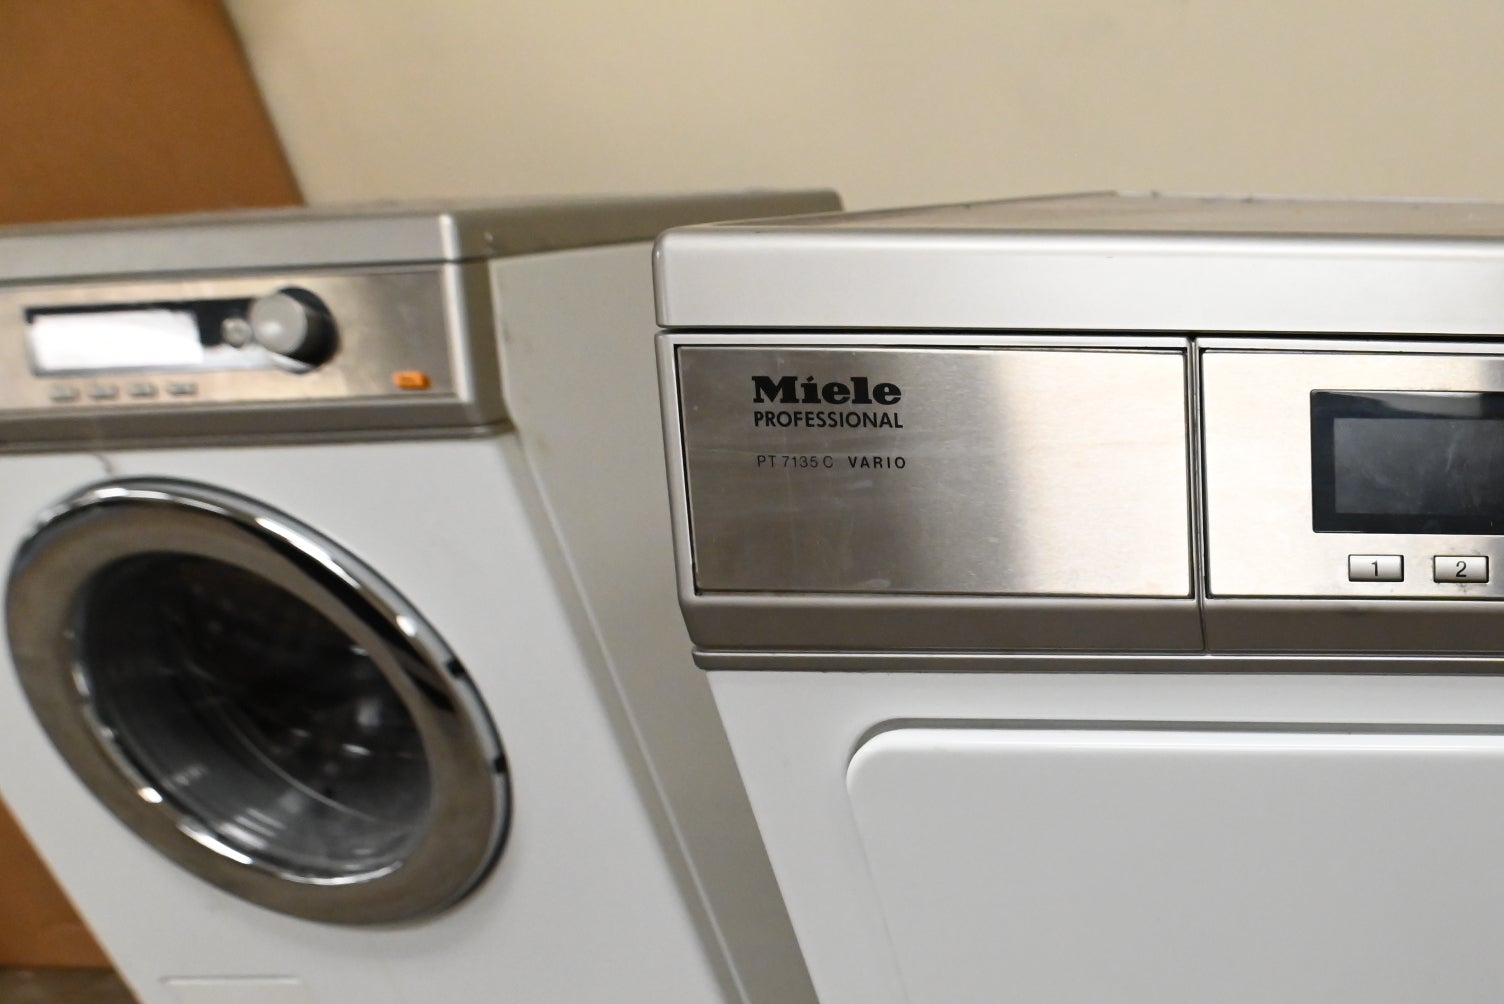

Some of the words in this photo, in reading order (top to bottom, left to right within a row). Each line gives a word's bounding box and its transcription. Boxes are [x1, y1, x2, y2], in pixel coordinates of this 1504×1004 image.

[751, 375, 902, 405] Miele
[753, 410, 904, 429] PROFESSIONAL
[757, 455, 777, 468] PT
[783, 455, 819, 469] 7135
[847, 456, 906, 469] VARIO
[1371, 559, 1379, 577] 1
[1455, 560, 1467, 578] 2
